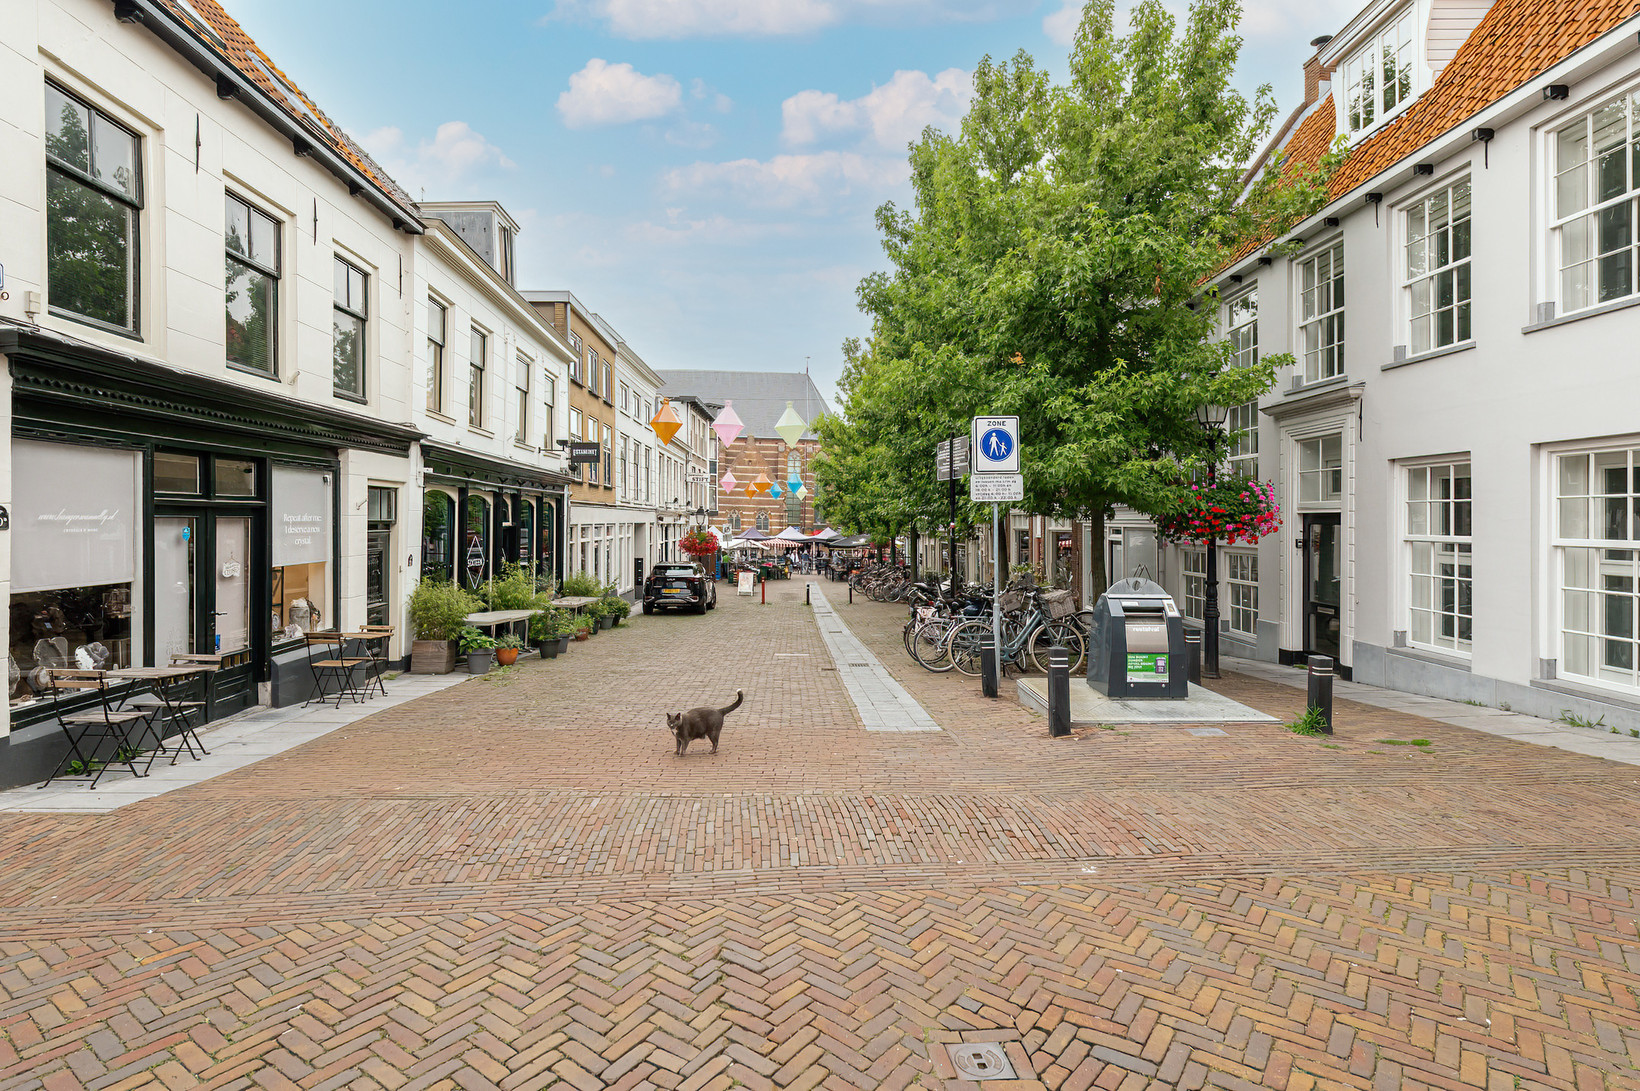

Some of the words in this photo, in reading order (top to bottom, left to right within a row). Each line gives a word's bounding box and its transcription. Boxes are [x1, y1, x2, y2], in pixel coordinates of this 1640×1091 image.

[283, 513, 301, 523] Repeat
[302, 513, 312, 521] after
[288, 525, 307, 533] deserve
